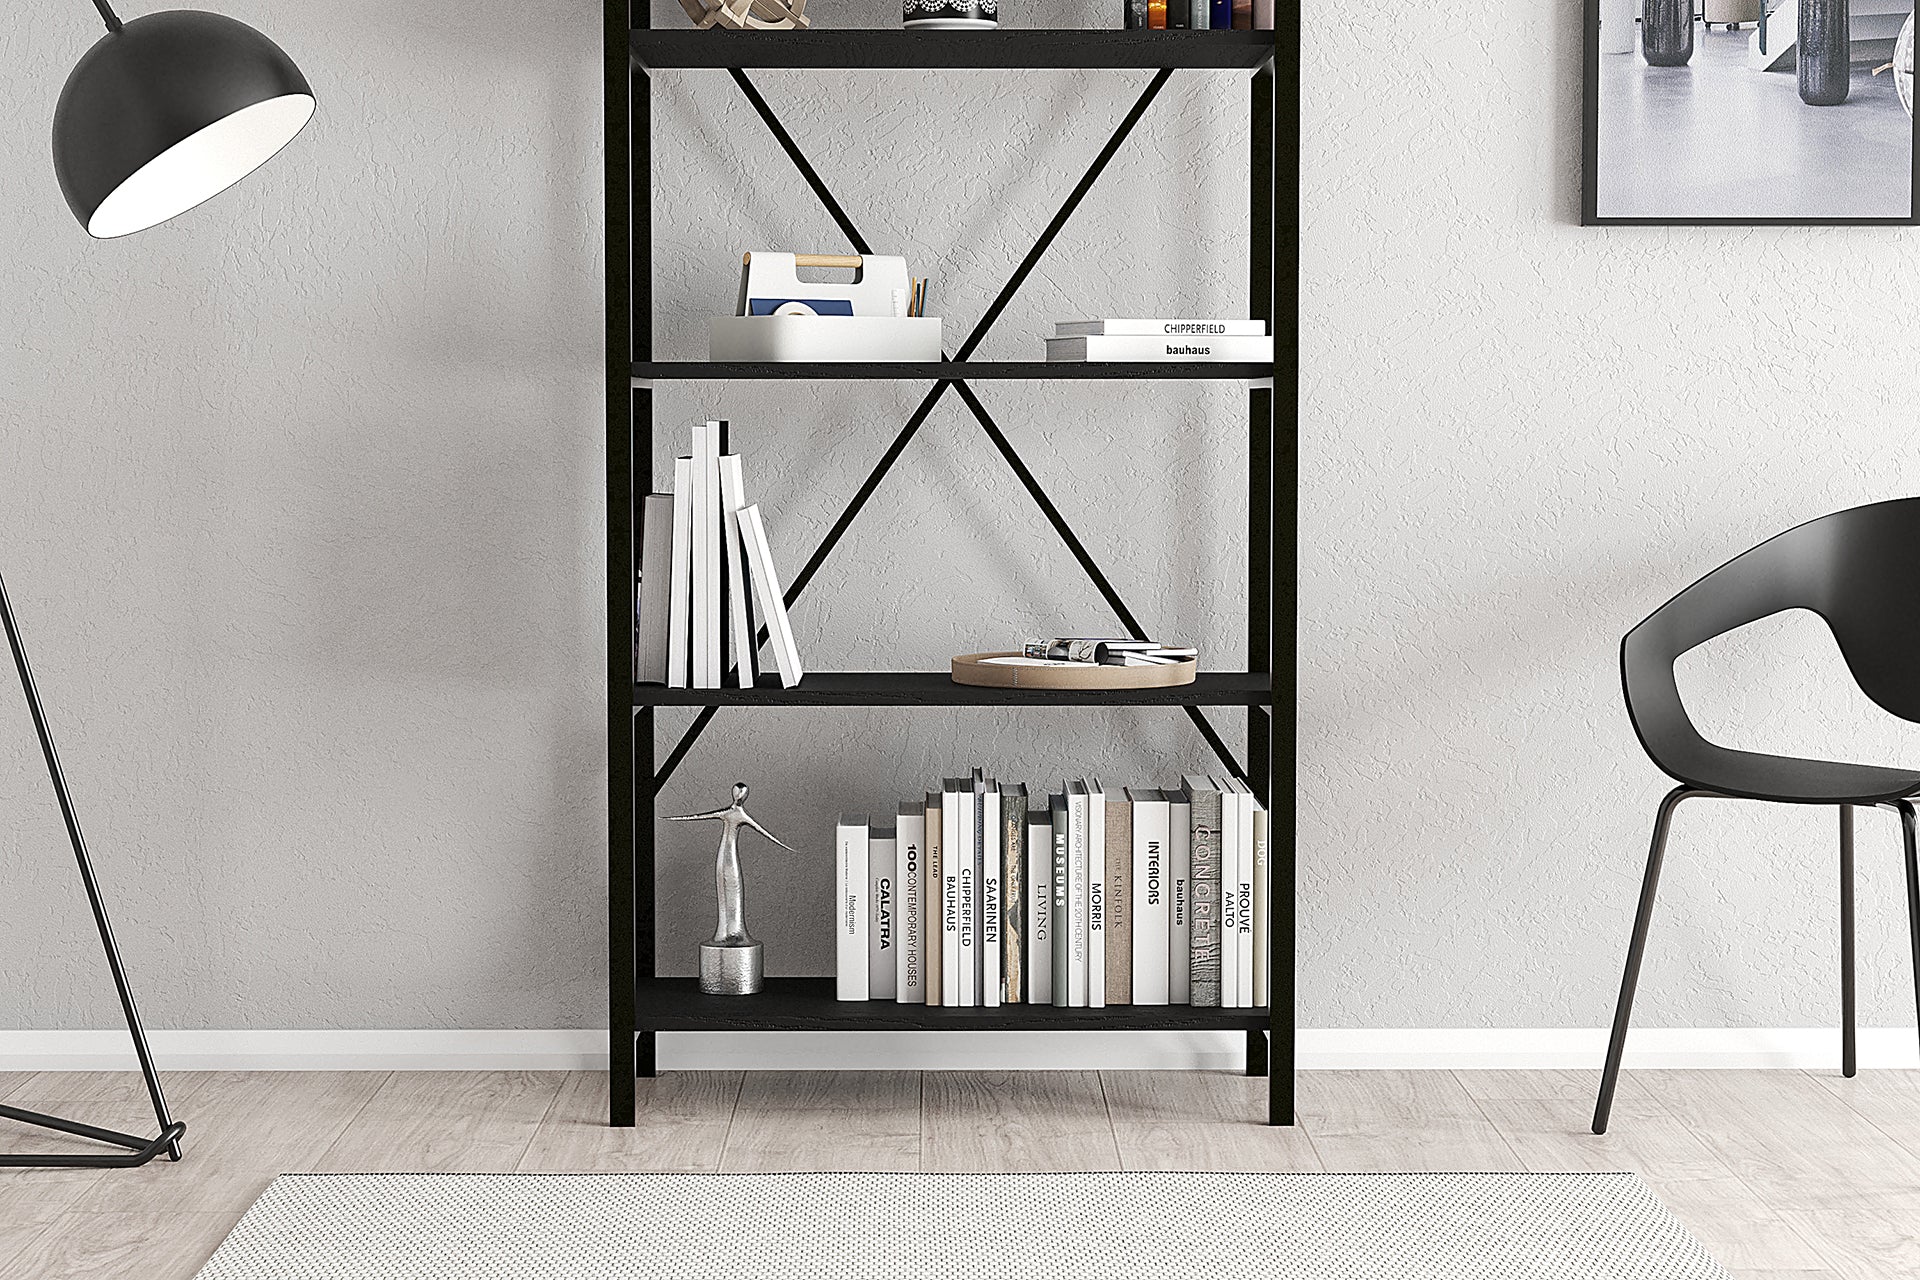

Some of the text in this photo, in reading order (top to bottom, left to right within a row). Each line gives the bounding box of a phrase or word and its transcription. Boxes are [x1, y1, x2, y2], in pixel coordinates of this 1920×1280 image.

[1164, 323, 1226, 334] CHIPPERFIELD
[1166, 344, 1211, 355] bauhaus
[1055, 834, 1065, 907] MUSEUMS
[1148, 841, 1160, 905] INTERIORS
[1257, 839, 1266, 867] DOG
[946, 876, 956, 932] BAUHAUS
[962, 868, 971, 947] CHIPPERFIELD
[1074, 801, 1083, 963] VISIONARY ARCHITECTURE OF THE 20TH CENTURY
[1091, 883, 1102, 931] MORRIS
[1114, 875, 1123, 929] KINFOLK
[1176, 879, 1185, 926] bauhaus
[1193, 825, 1211, 962] CONCRETE
[1239, 883, 1252, 934] PROUVÉ
[848, 895, 857, 935] Modernism
[880, 878, 891, 950] CALATRA
[985, 878, 997, 943] SAARINEN
[1037, 884, 1047, 941] LIVING
[1225, 891, 1235, 928] AALTO
[907, 949, 917, 987] HOUSES
